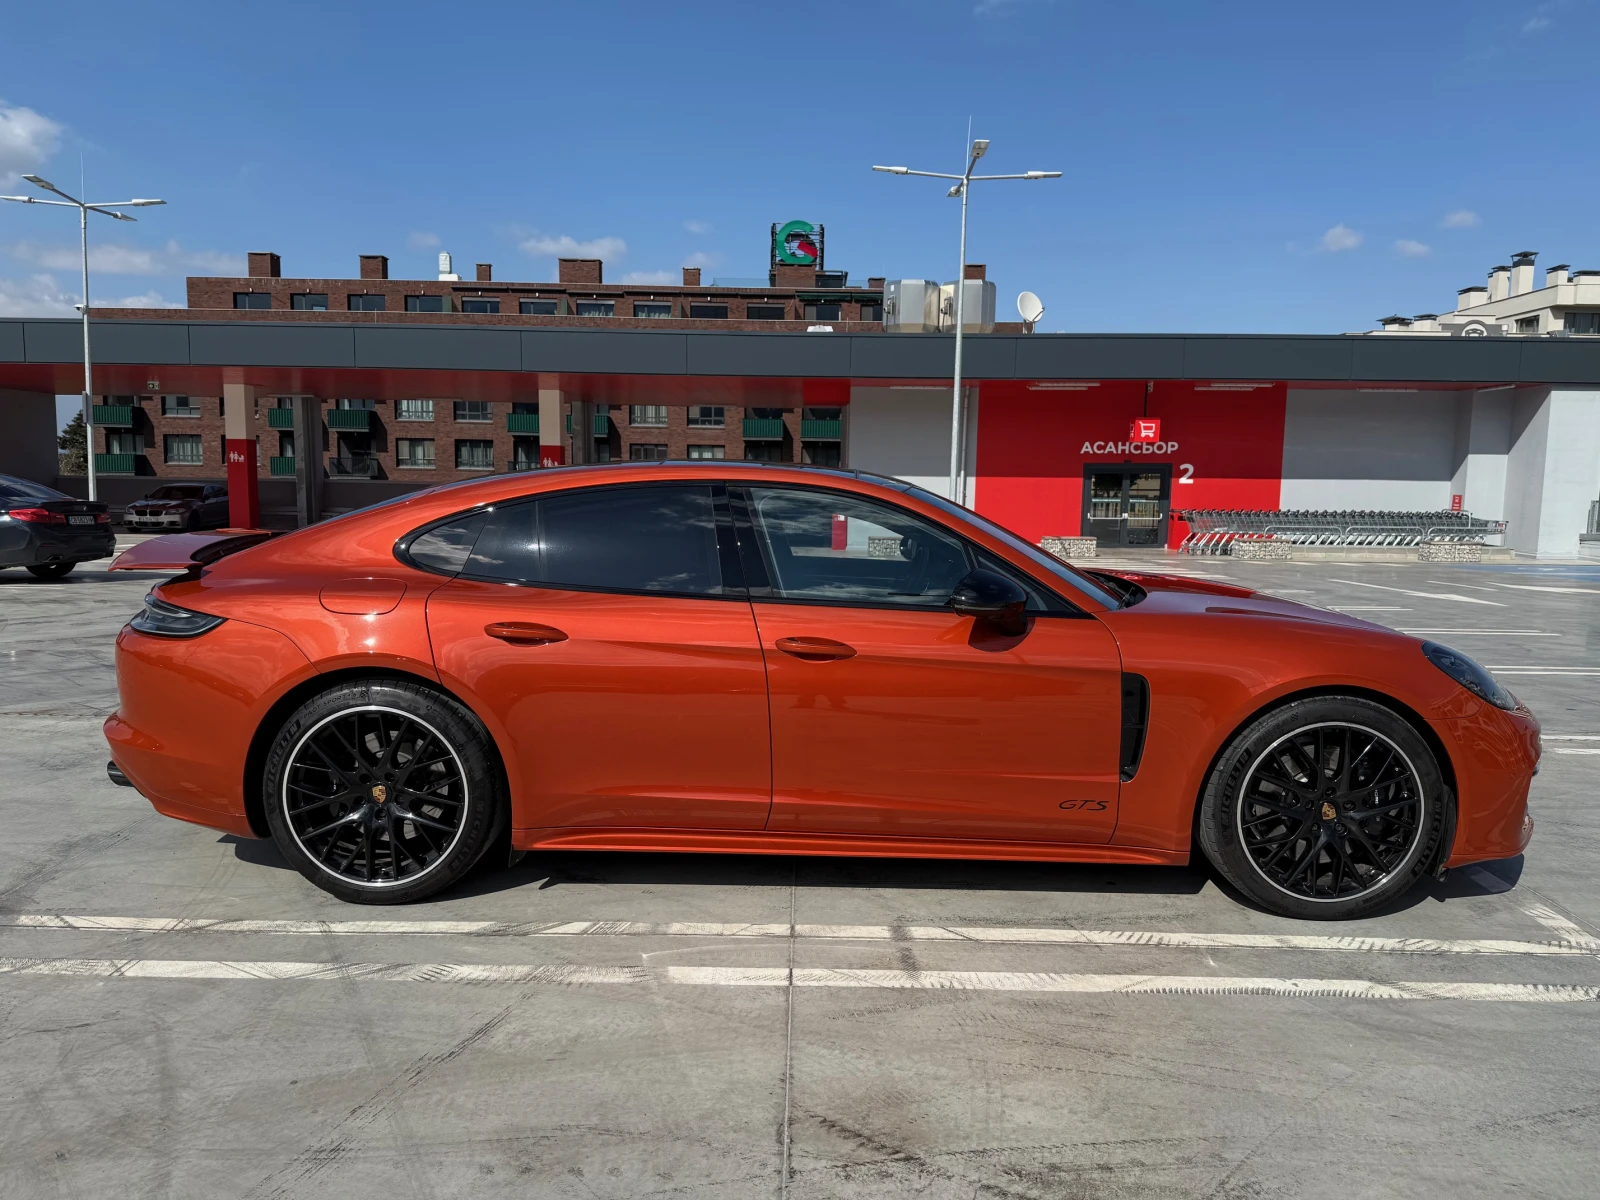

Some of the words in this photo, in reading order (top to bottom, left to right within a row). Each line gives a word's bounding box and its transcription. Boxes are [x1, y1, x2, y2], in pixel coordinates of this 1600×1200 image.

[1080, 441, 1179, 455] АСАНСЬОР
[1178, 463, 1194, 485] 2
[303, 704, 320, 719] PILOT
[323, 693, 346, 707] SPORT
[266, 722, 300, 794] MICHELIN
[1058, 799, 1110, 811] GTS
[1221, 752, 1250, 824] MICHELIN
[451, 799, 486, 871] MICHELIN
[1415, 801, 1443, 874] MICHELIN
